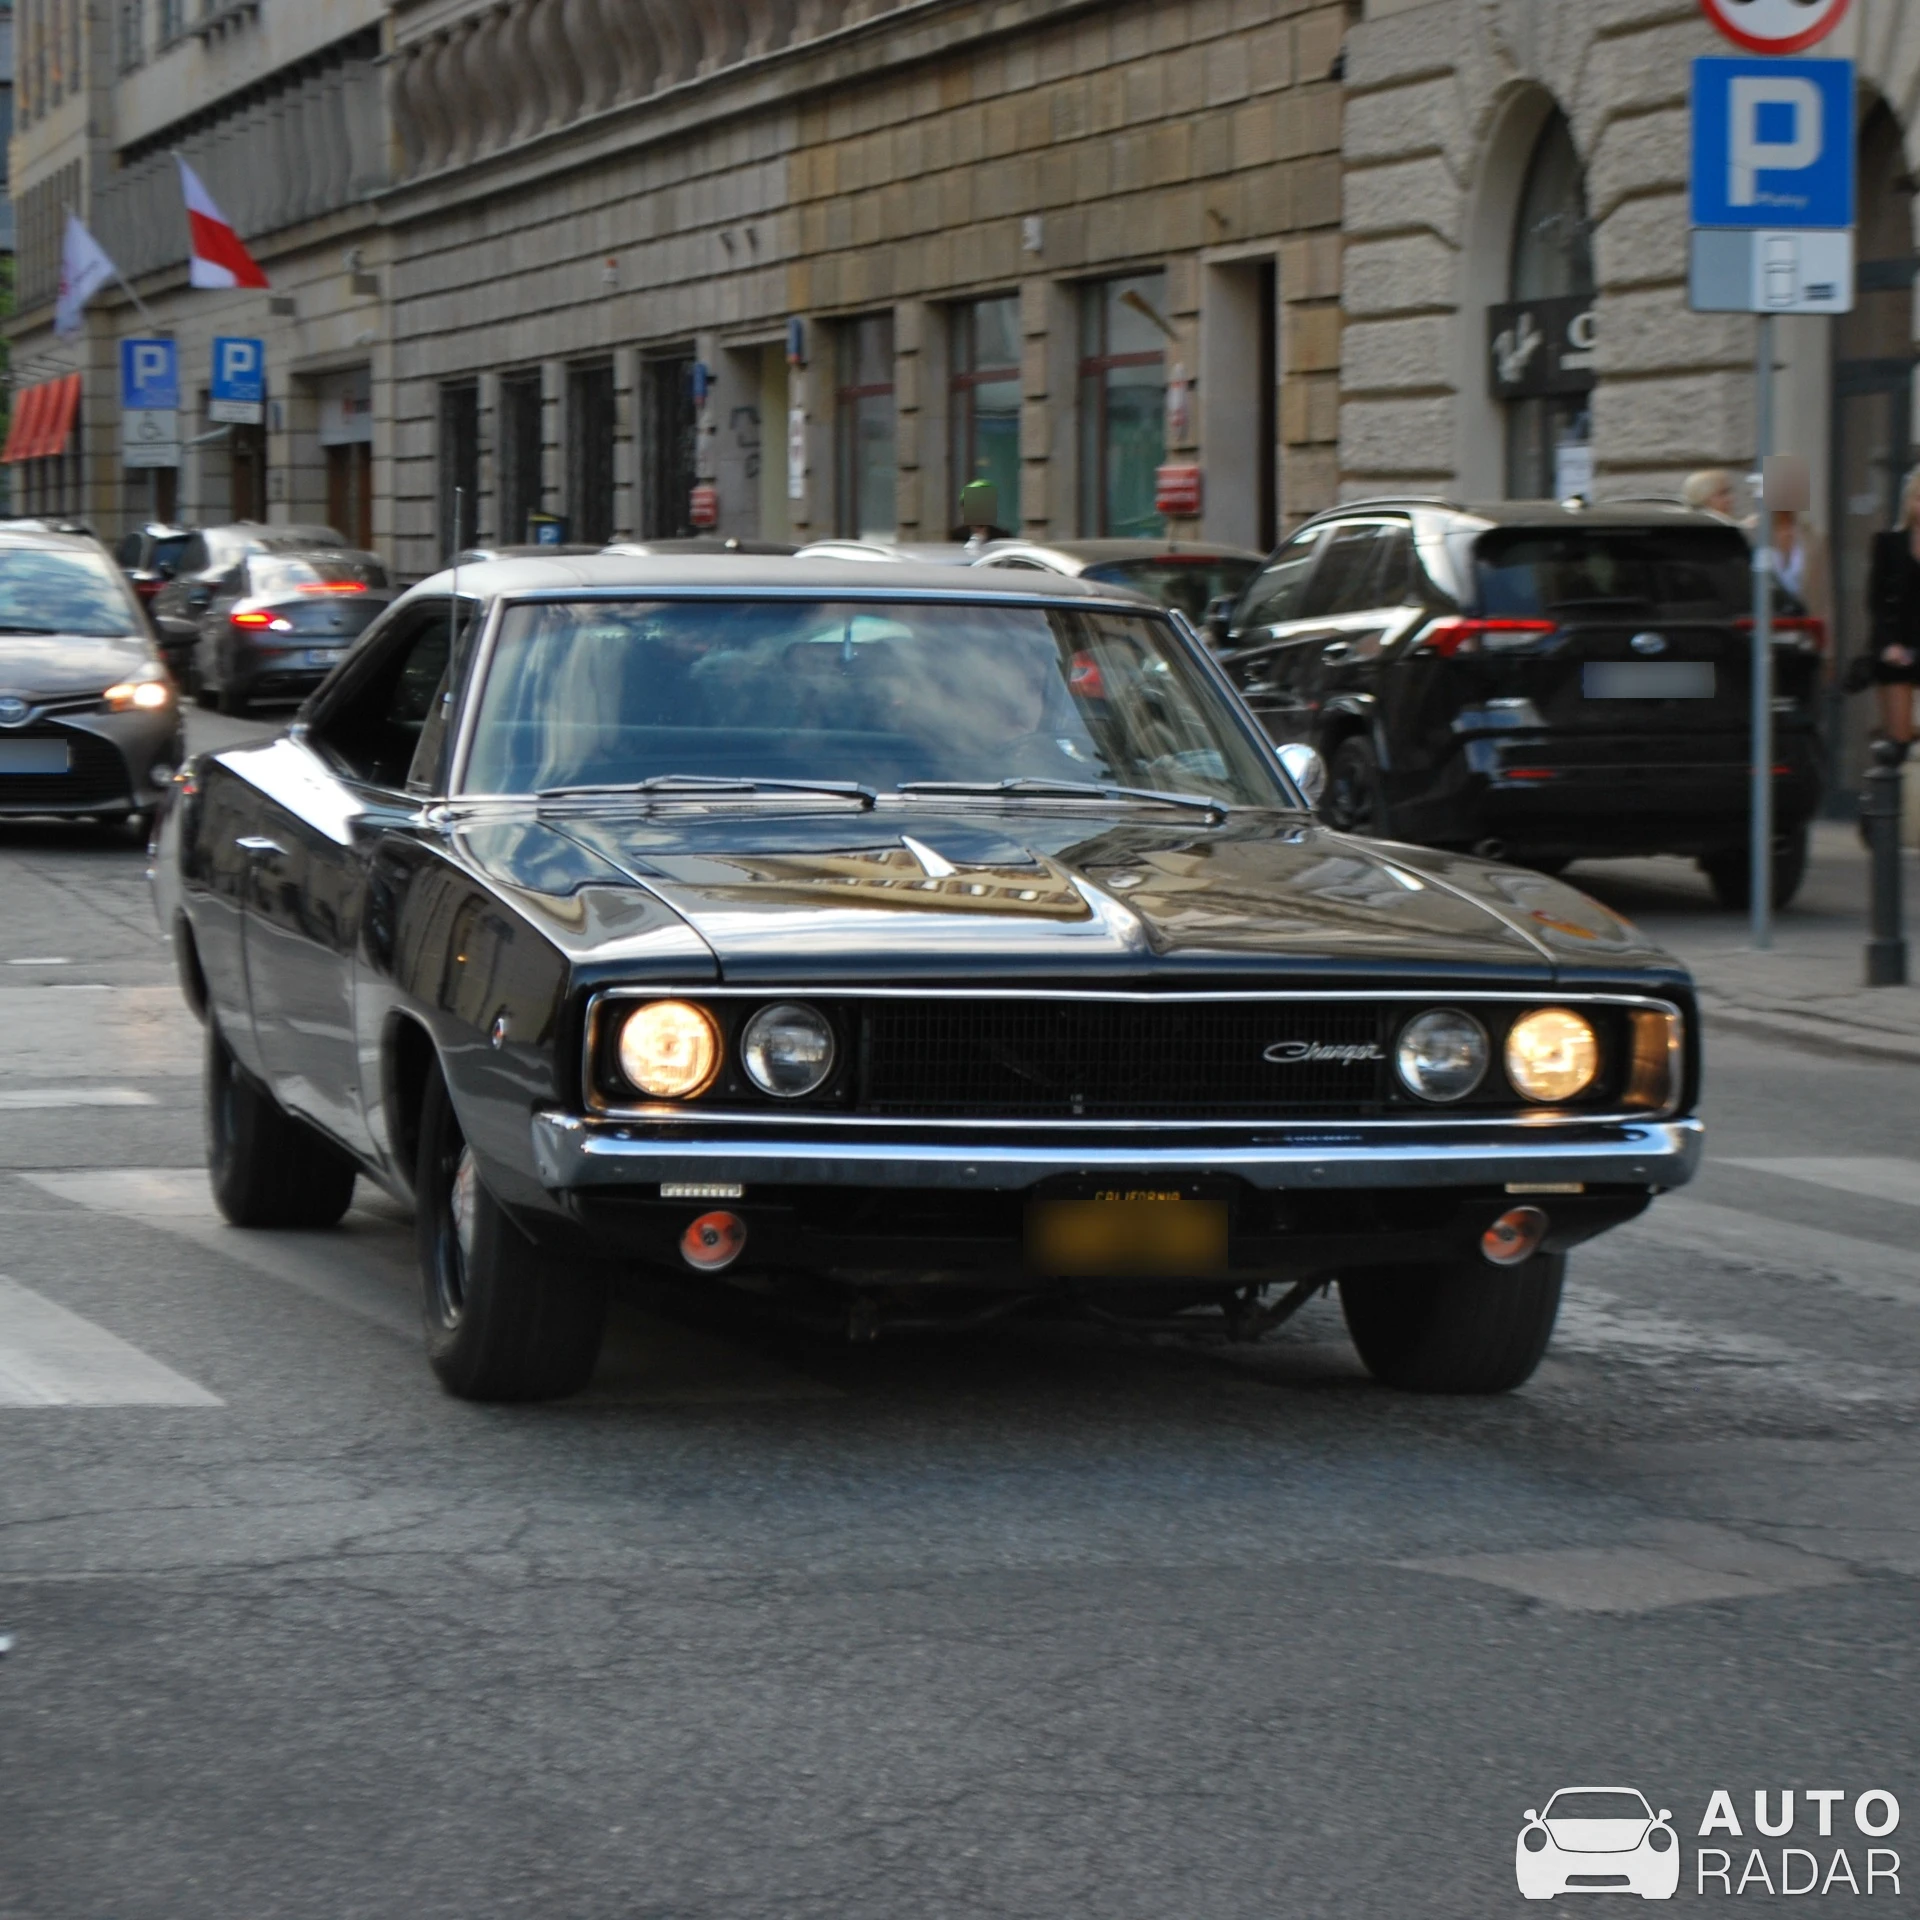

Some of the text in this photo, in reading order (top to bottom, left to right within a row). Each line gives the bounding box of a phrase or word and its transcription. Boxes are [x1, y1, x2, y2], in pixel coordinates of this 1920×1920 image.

[1728, 75, 1823, 207] P
[133, 345, 167, 389] P
[222, 343, 255, 382] P
[1263, 1041, 1386, 1066] Charger
